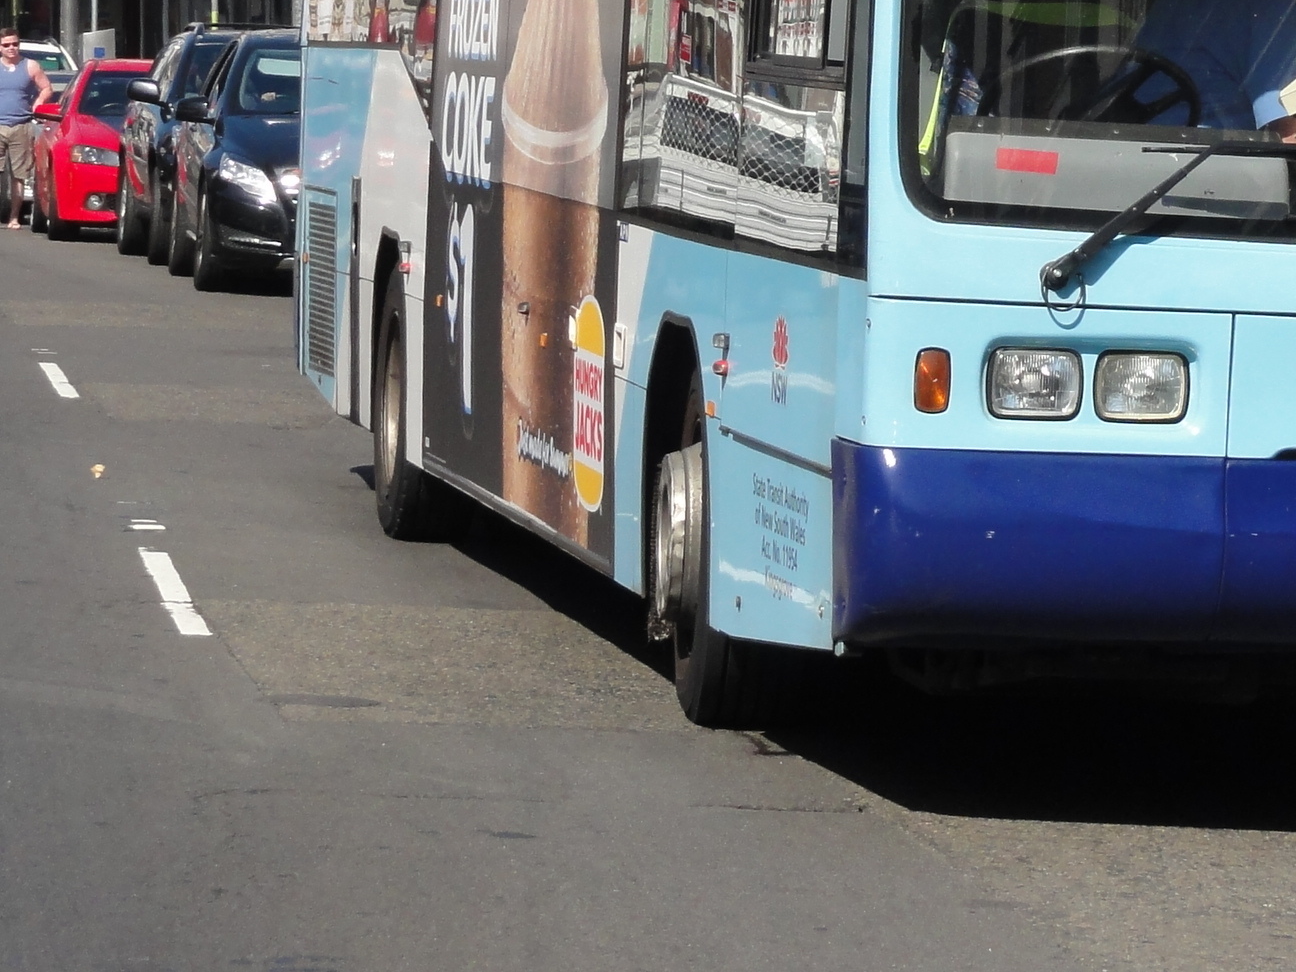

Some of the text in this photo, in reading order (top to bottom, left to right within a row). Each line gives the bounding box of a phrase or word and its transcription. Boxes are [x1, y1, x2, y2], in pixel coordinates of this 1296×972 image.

[442, 72, 496, 190] COKE
[575, 356, 603, 403] HUNGRY
[771, 370, 788, 406] NSW
